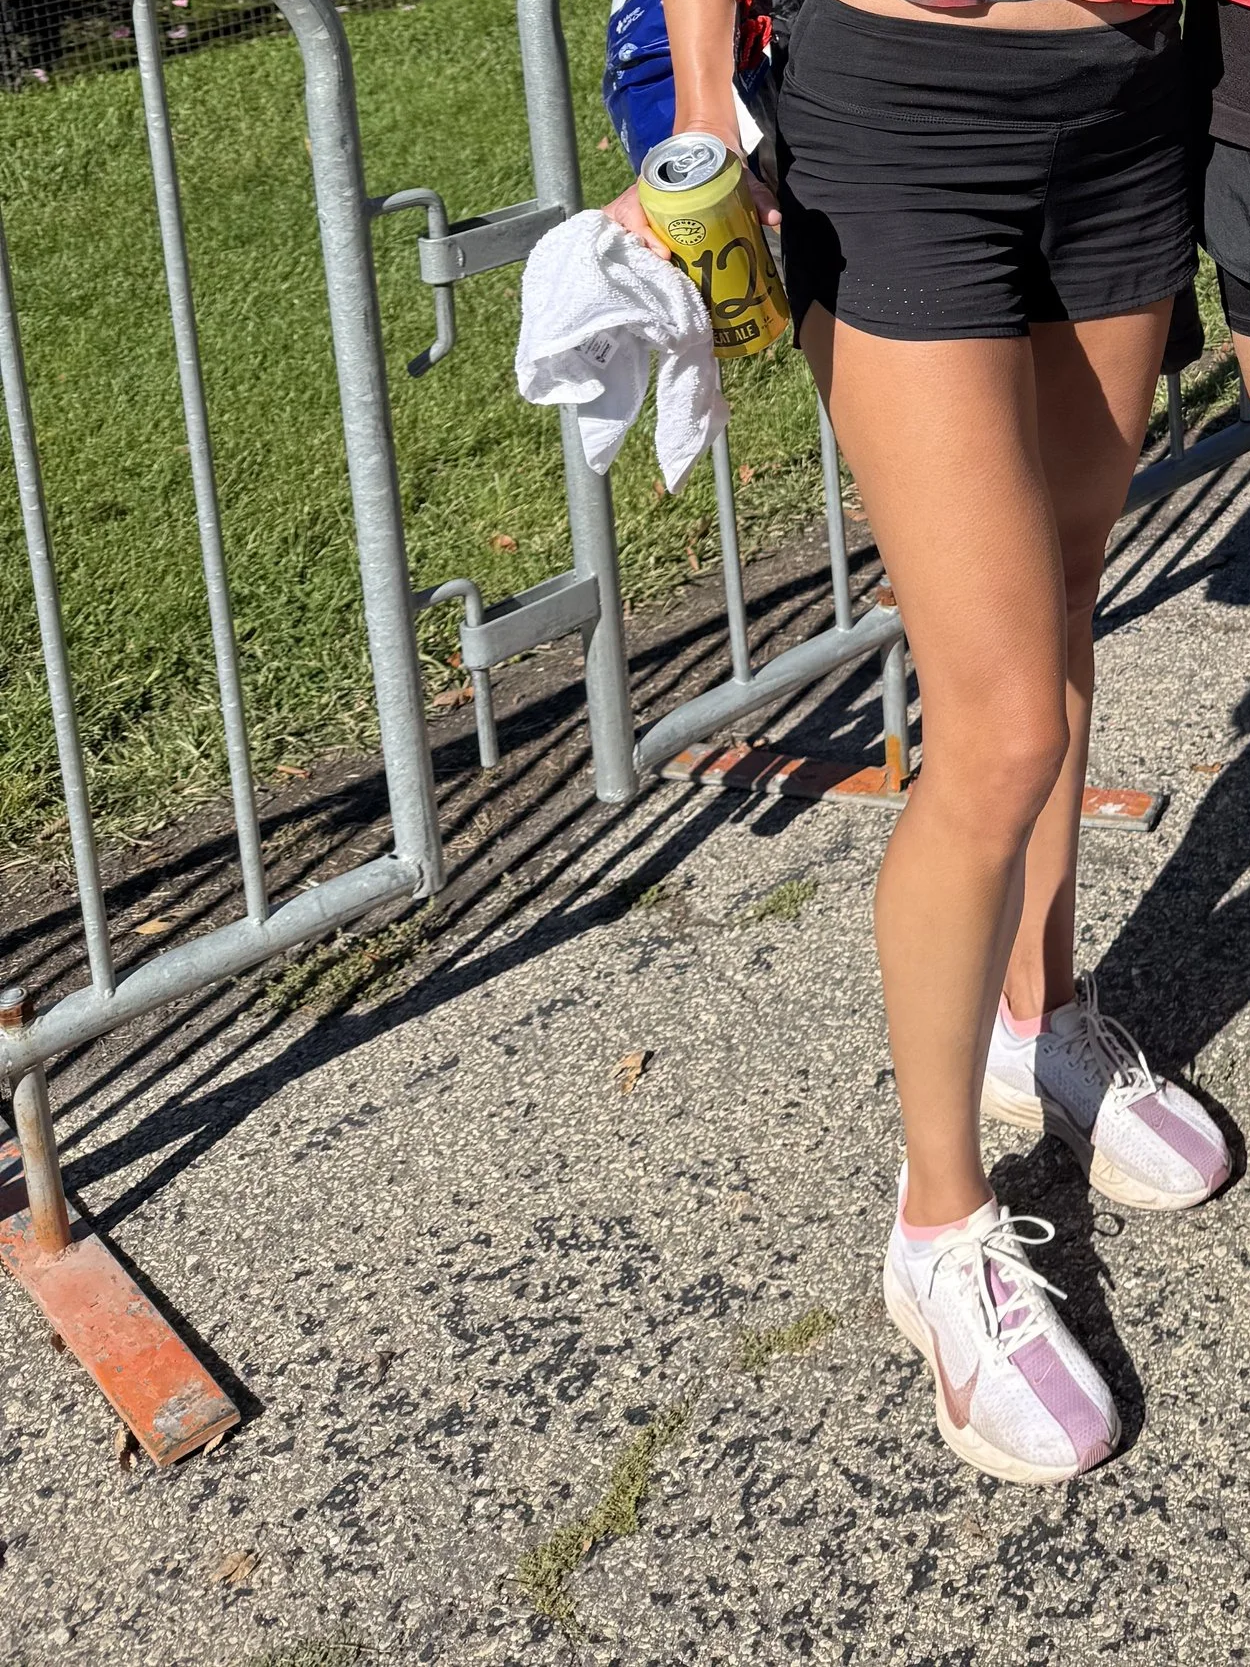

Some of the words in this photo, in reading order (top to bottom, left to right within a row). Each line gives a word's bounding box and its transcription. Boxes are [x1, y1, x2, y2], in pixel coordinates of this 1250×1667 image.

[671, 236, 767, 320] 12
[714, 331, 730, 345] EAT
[735, 324, 754, 342] ALE
